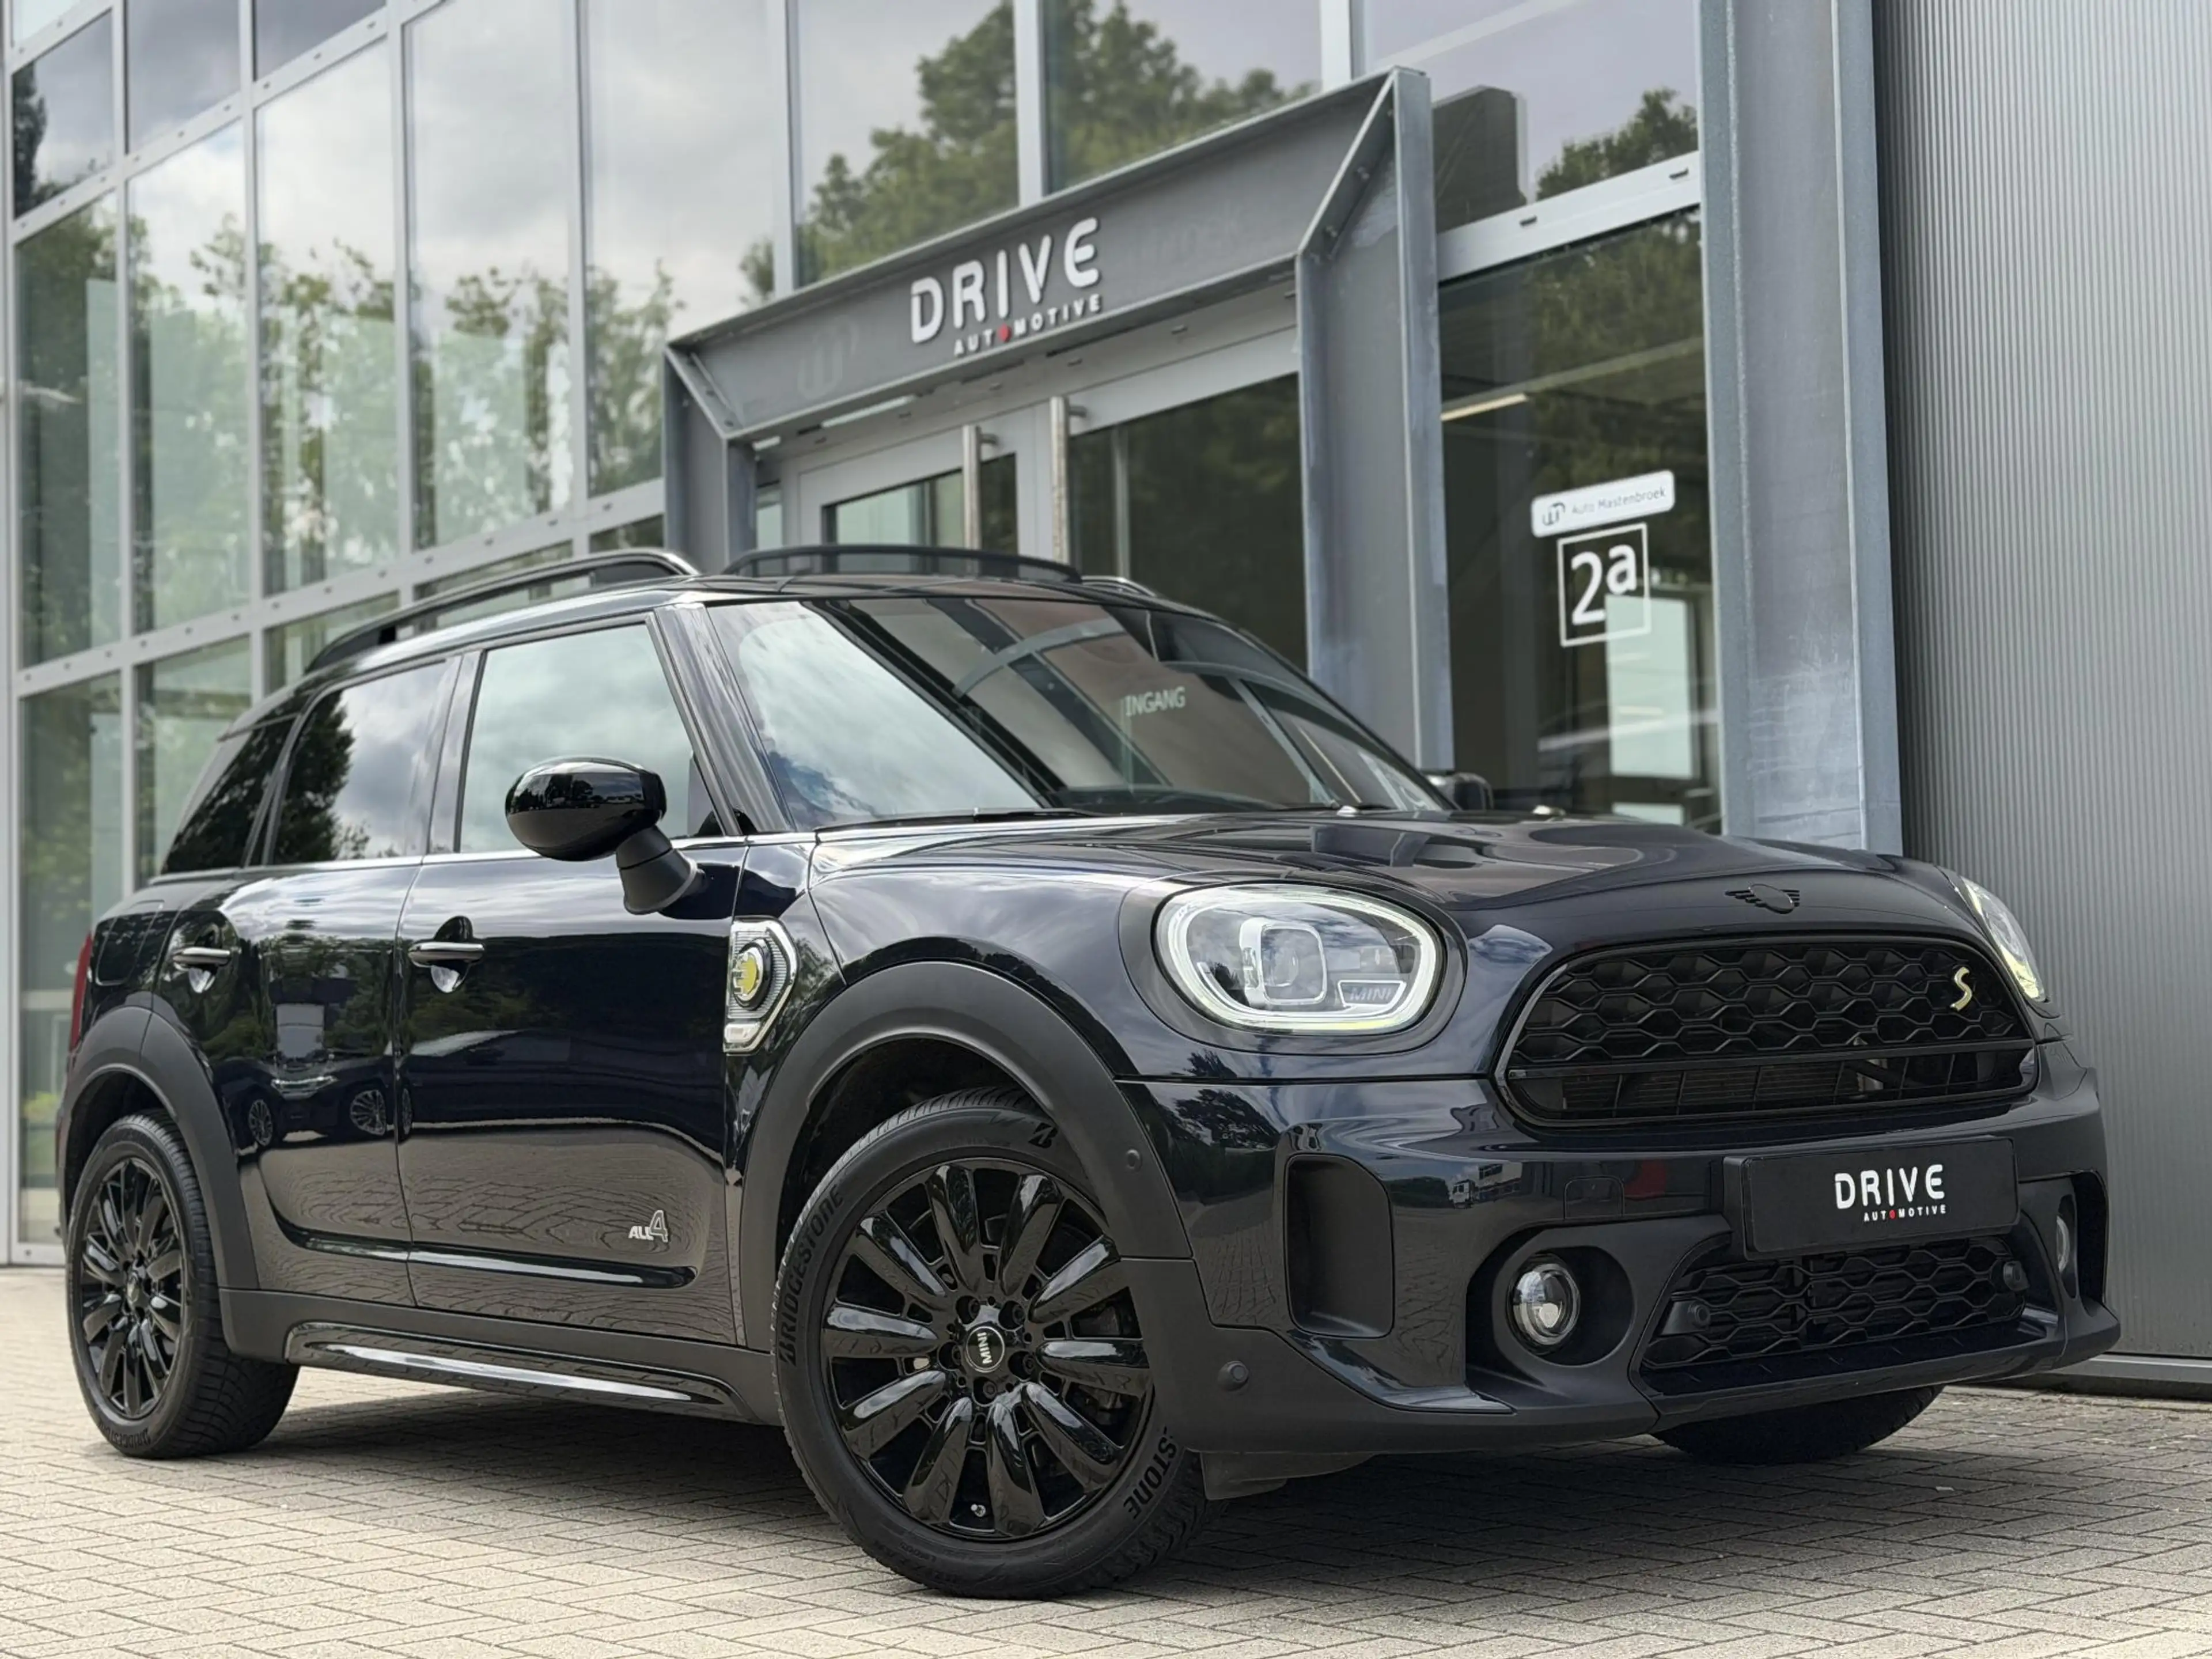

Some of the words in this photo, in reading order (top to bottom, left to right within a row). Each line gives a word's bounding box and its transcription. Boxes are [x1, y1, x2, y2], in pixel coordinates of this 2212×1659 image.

[911, 217, 1099, 344] DRIVE
[953, 294, 1102, 356] AUTOMOTIVE
[1598, 486, 1666, 509] Mastenbroek
[1571, 544, 1637, 625] 2a
[1125, 685, 1185, 717] INGANG
[1350, 986, 1392, 1001] MINI
[1834, 1164, 1945, 1209] DRIVE
[1863, 1205, 1947, 1222] AUTOMOTIVE
[779, 1184, 844, 1368] BRIDGESTONE
[977, 1331, 993, 1365] MINI
